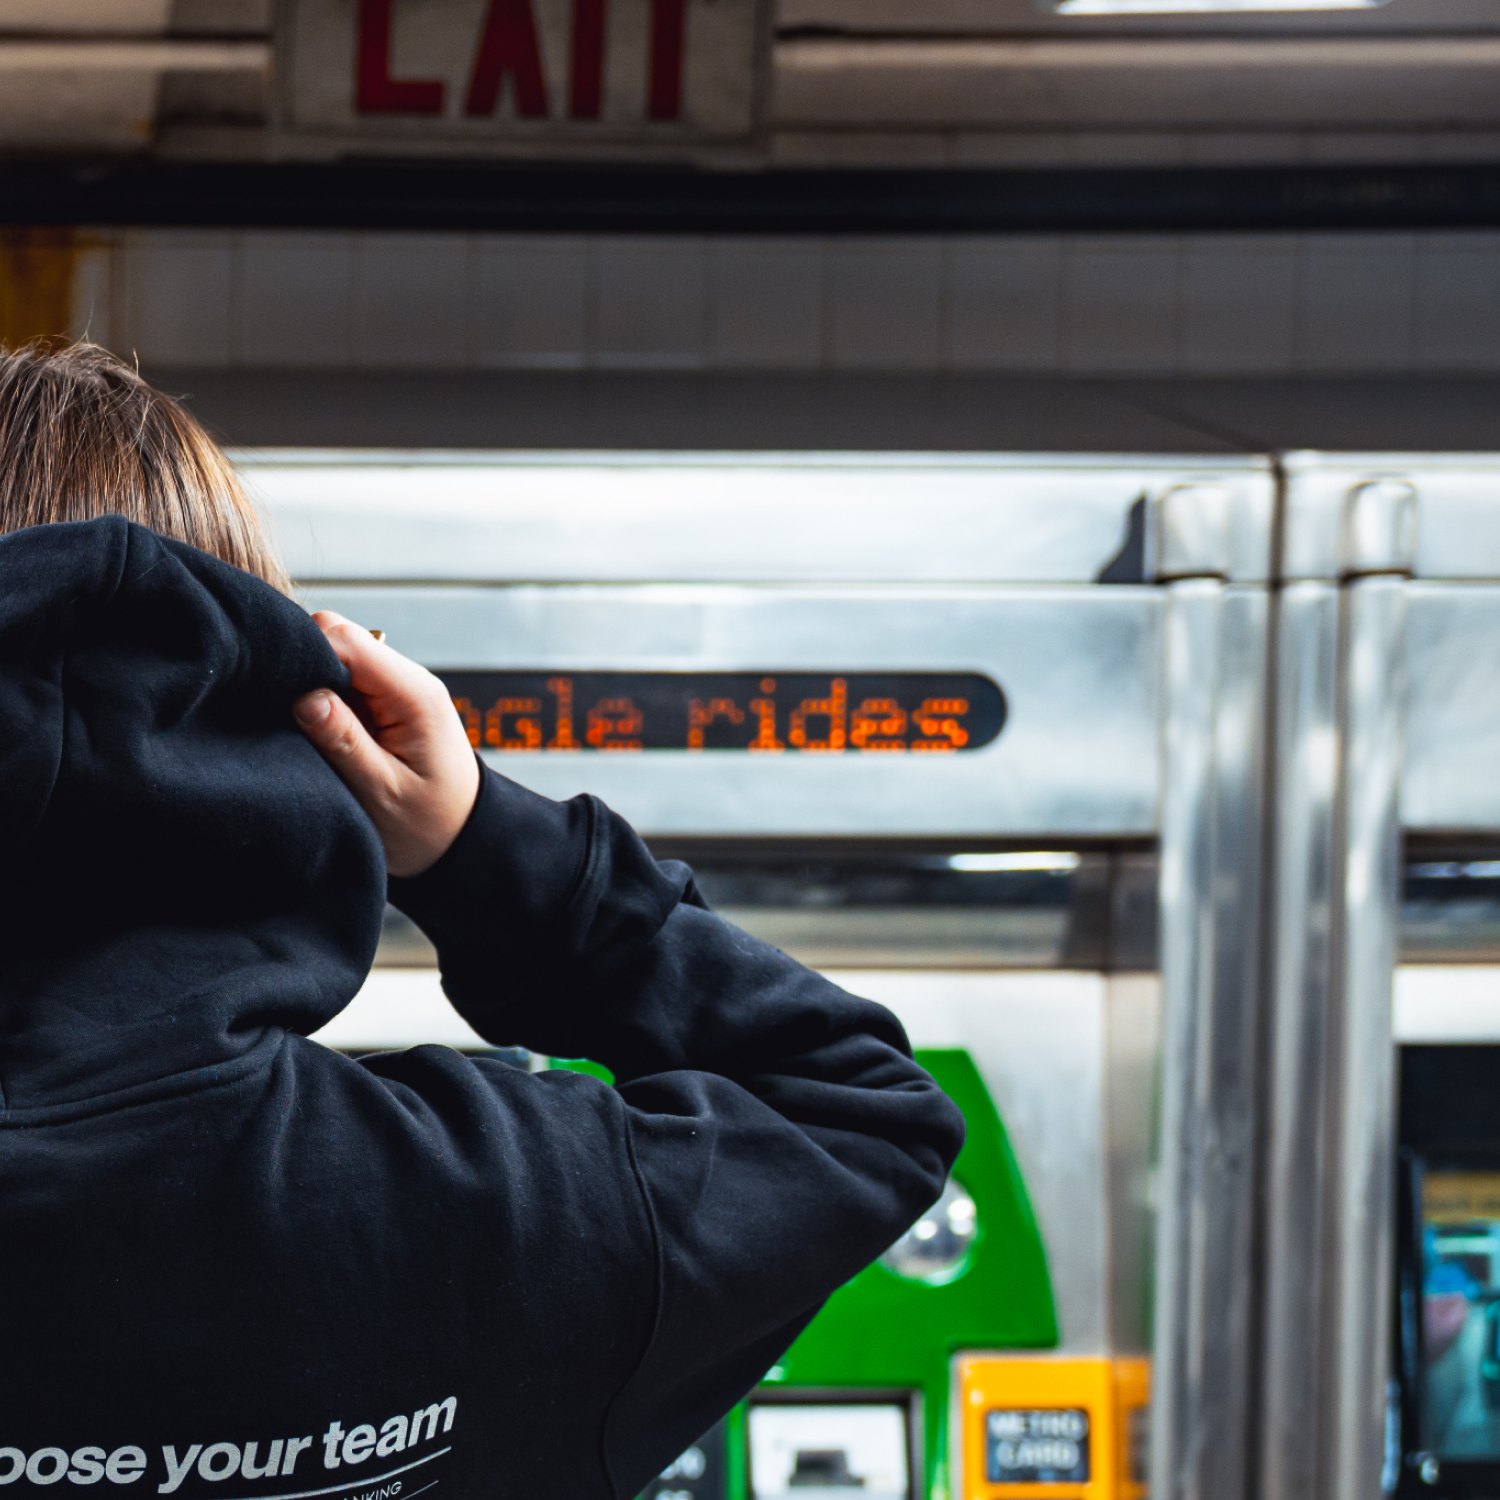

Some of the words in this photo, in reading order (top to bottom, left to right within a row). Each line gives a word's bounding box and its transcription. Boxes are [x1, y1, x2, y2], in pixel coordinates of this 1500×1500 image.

[687, 676, 970, 753] rides
[157, 1435, 313, 1494] your
[322, 1396, 457, 1469] team
